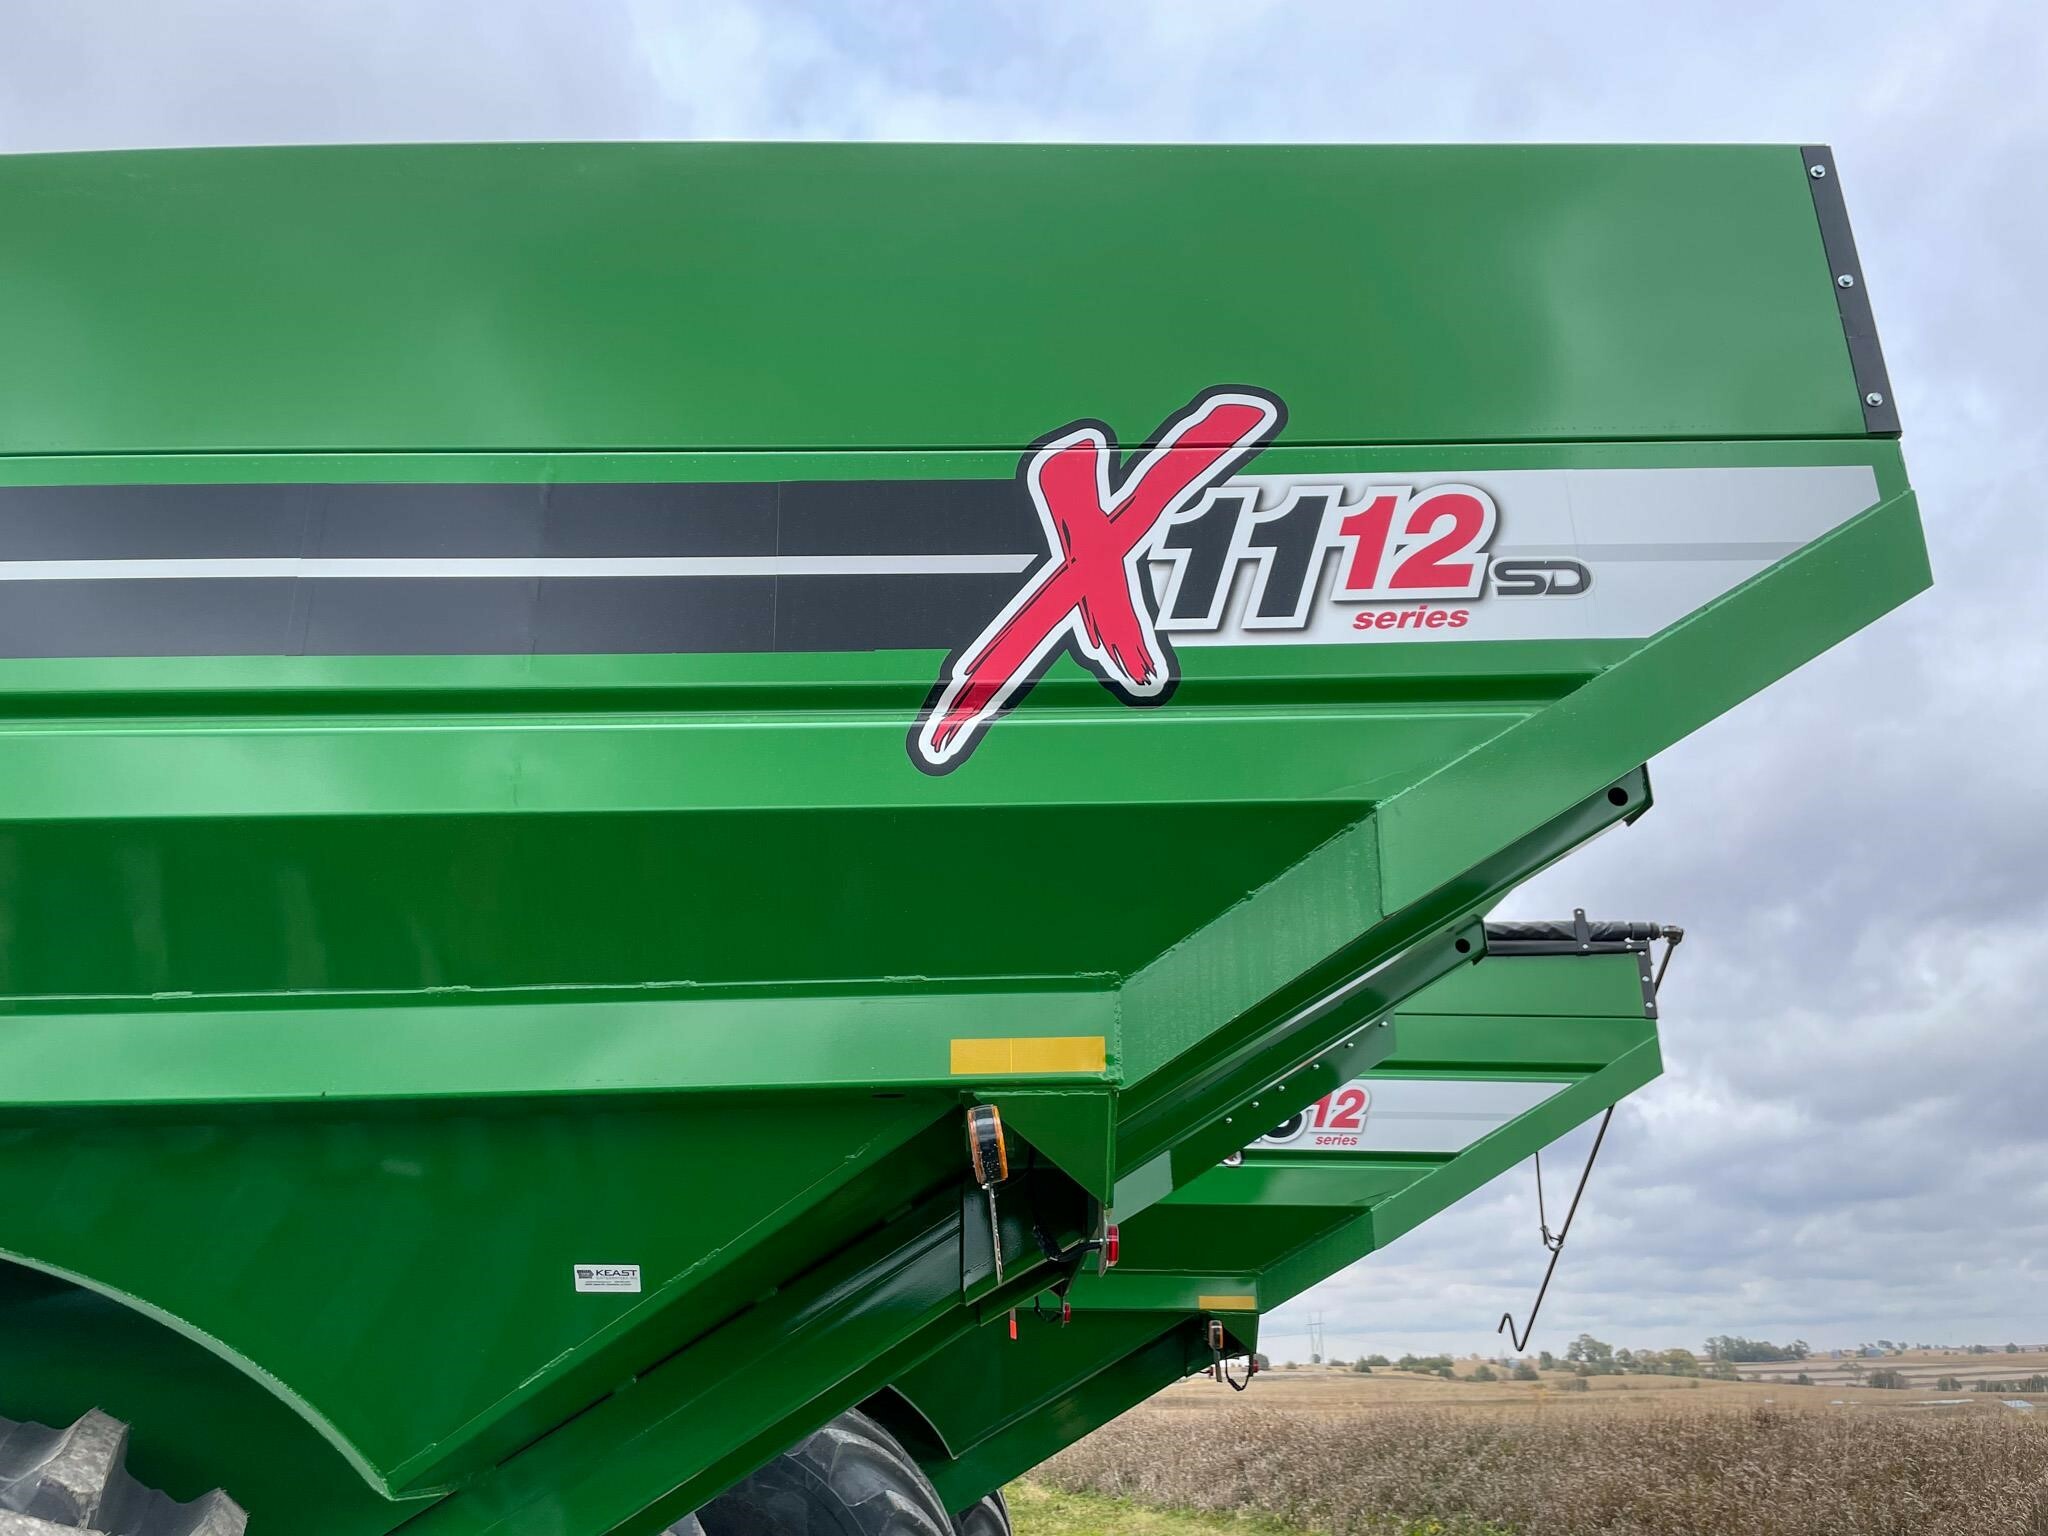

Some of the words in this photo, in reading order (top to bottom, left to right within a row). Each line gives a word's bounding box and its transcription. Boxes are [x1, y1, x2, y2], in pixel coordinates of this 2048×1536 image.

[1494, 561, 1591, 595] SD
[1353, 605, 1470, 630] series
[1314, 1133, 1358, 1146] series
[595, 1269, 637, 1277] KEAST
